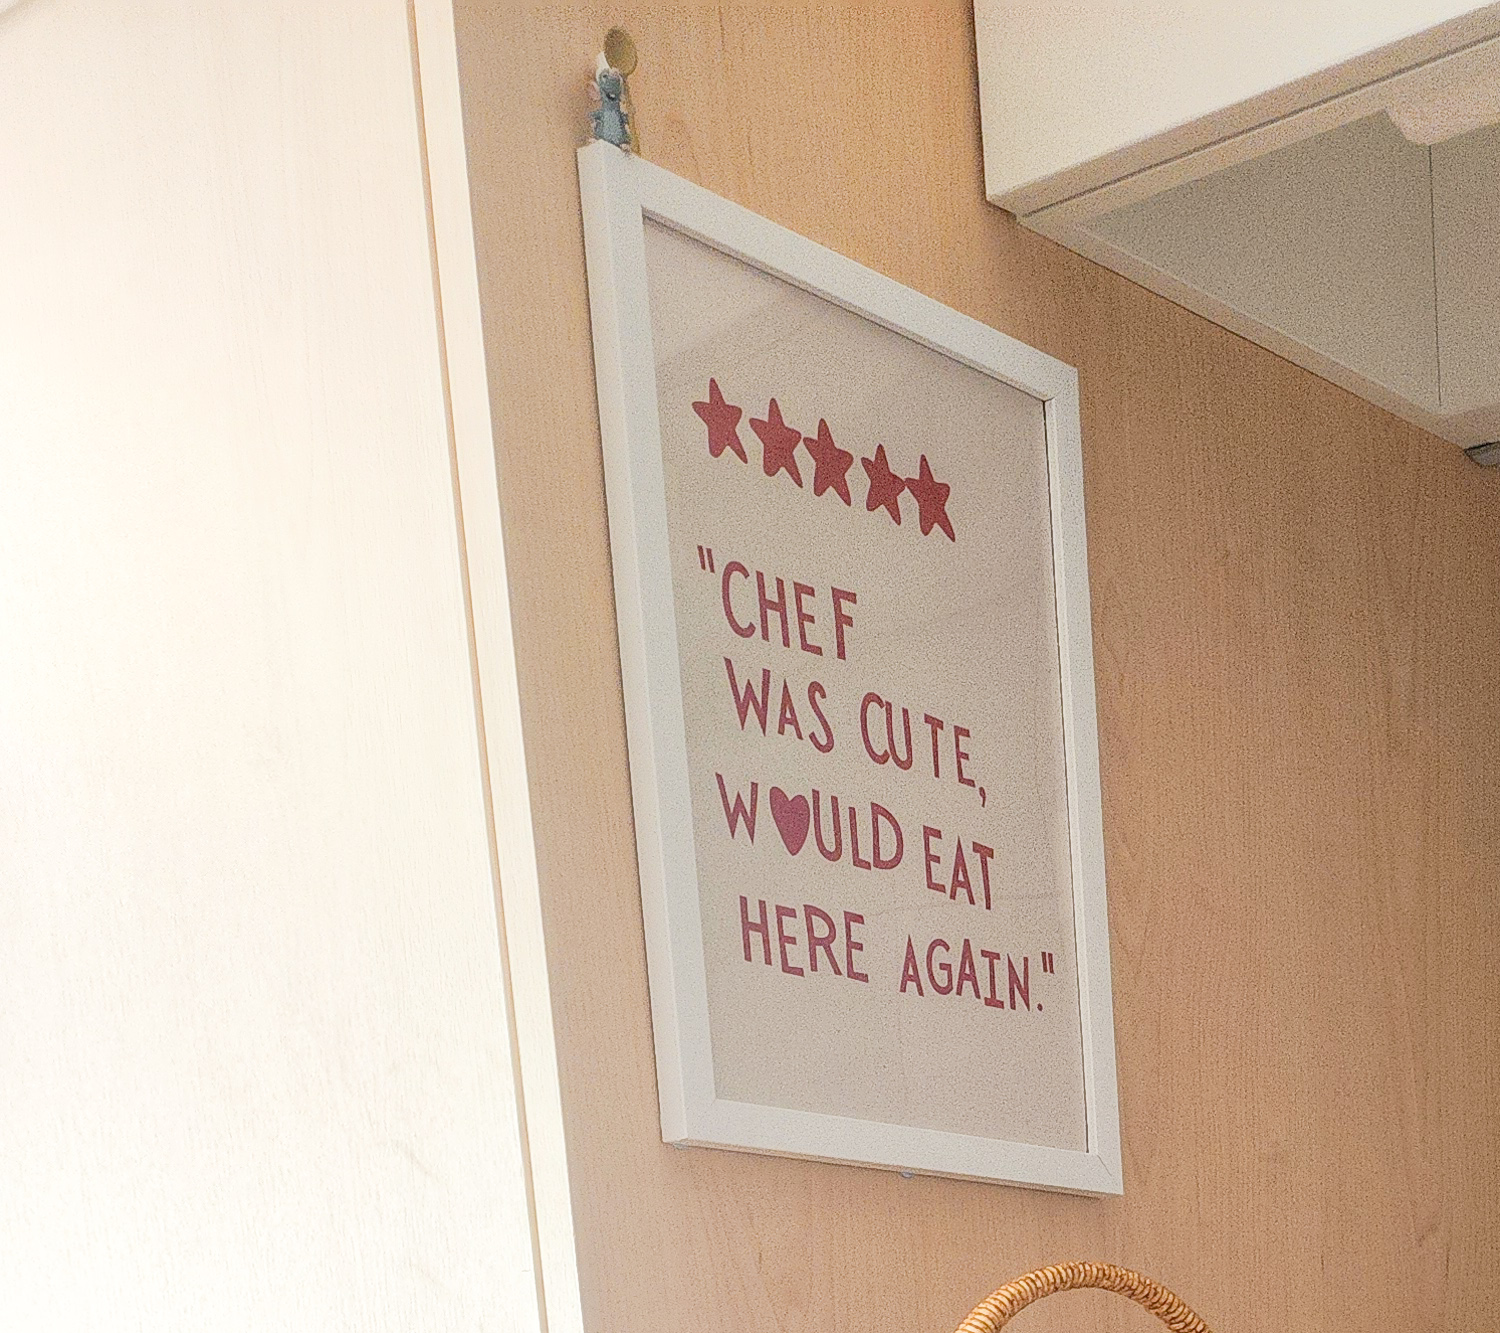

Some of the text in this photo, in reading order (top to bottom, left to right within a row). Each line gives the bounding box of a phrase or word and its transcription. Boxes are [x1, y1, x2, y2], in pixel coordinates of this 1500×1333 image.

[697, 545, 857, 661] "CHEF
[723, 657, 987, 807] WAS CUTE,
[922, 824, 995, 911] EAT
[739, 895, 1055, 1012] HERE AGAIN."
